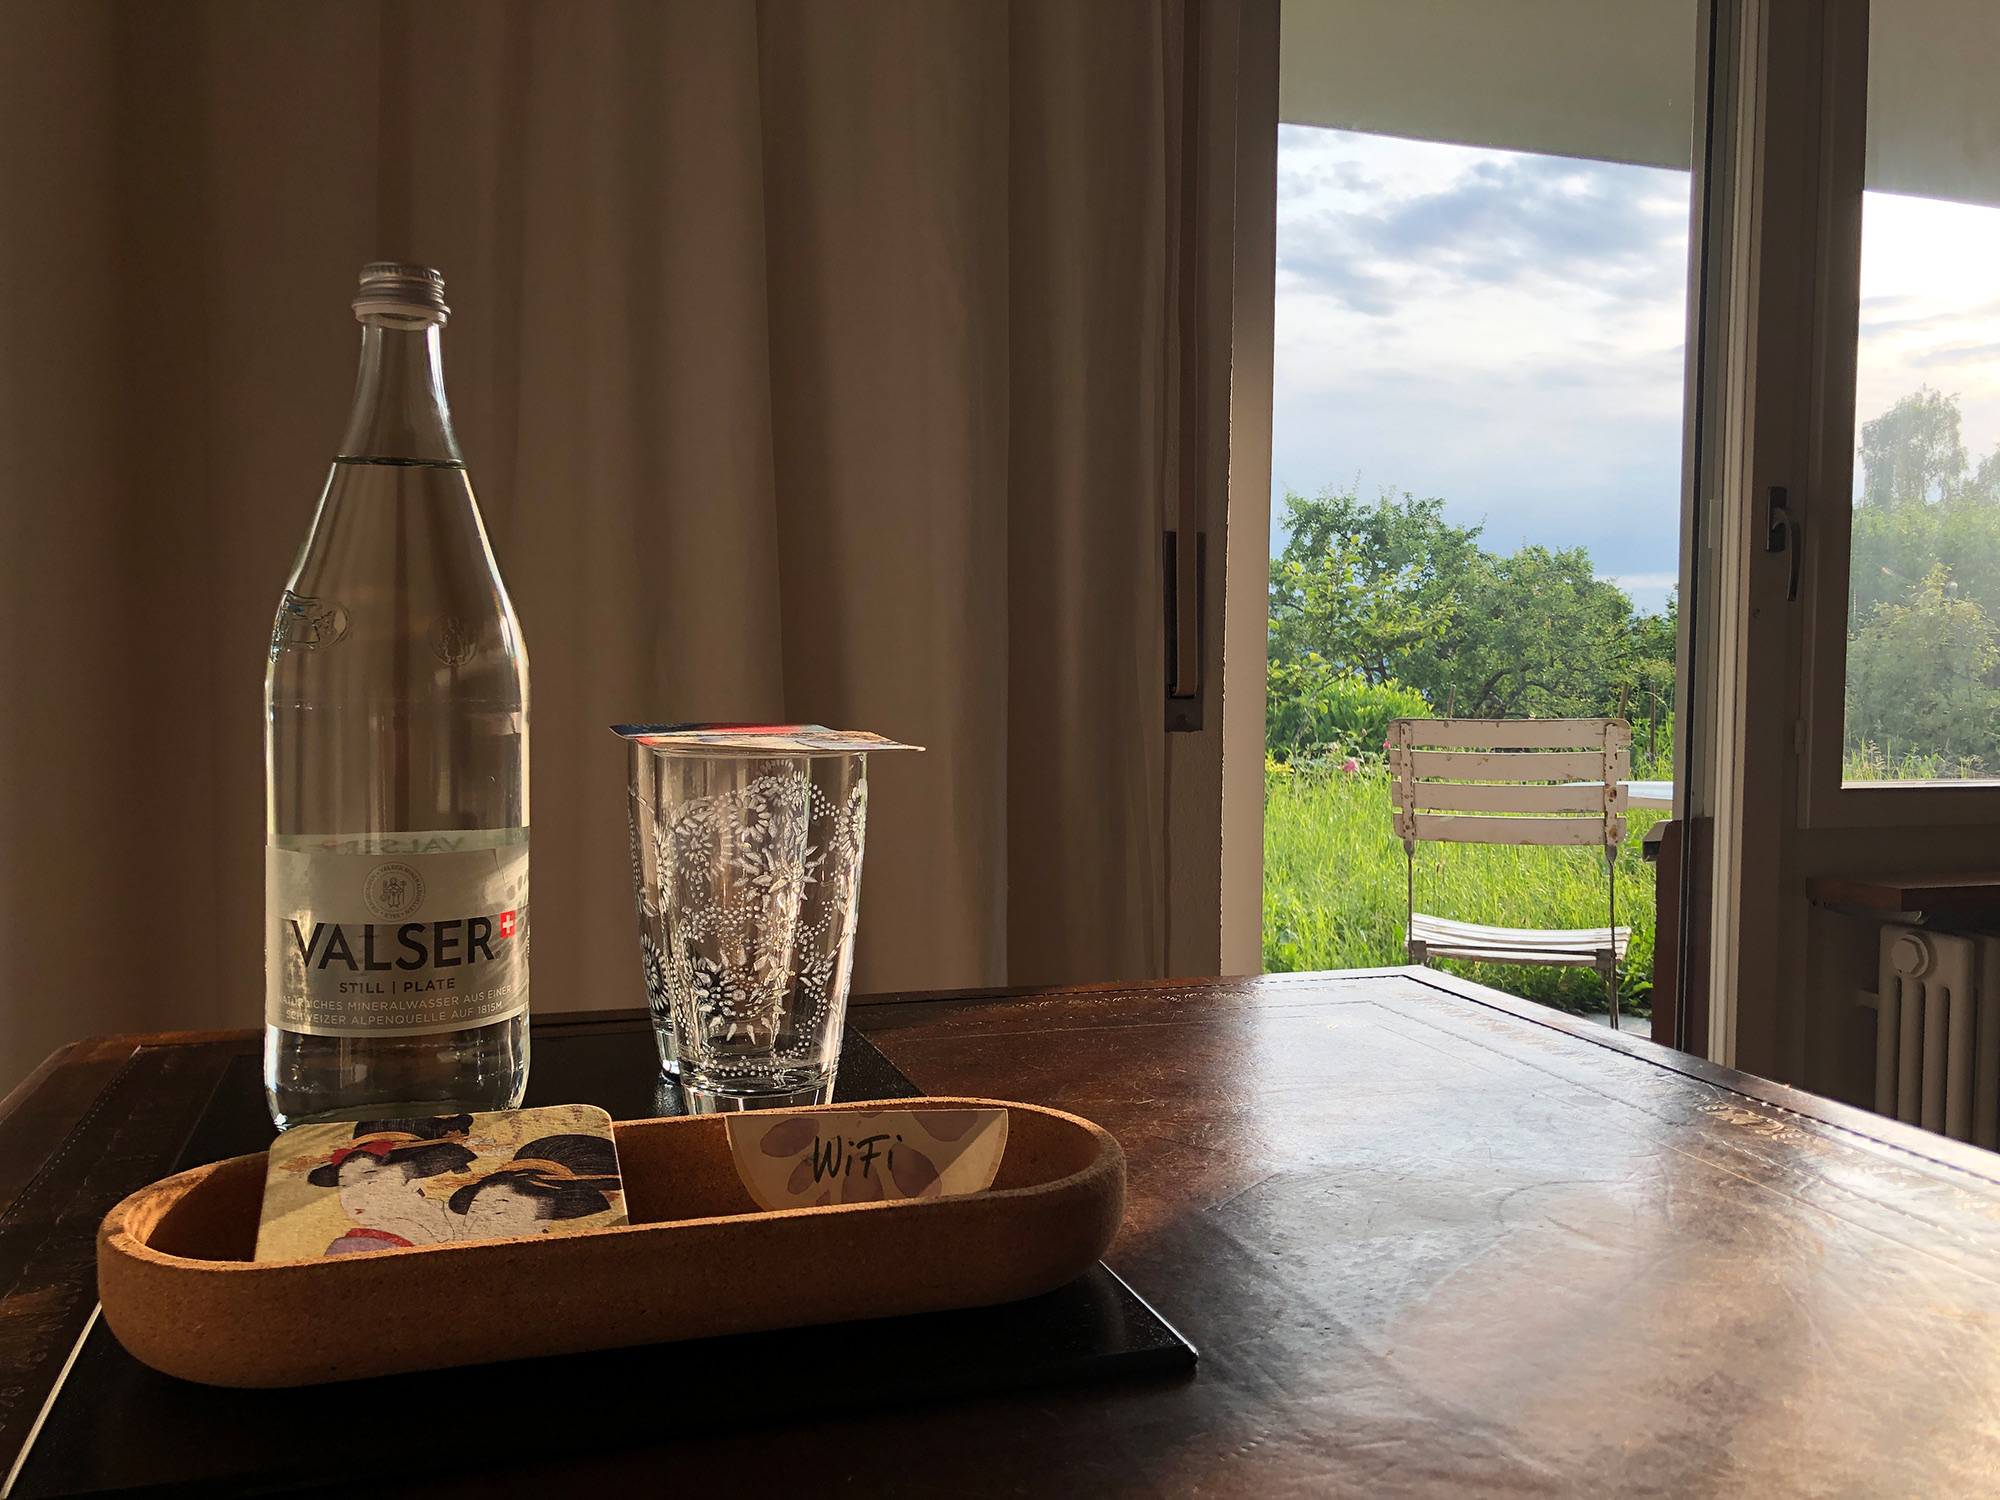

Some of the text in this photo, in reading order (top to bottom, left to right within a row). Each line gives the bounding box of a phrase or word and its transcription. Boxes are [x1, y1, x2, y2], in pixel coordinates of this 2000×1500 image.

[291, 916, 495, 971] VALSER
[279, 984, 512, 1012] ATÜRLICHES MINERALWASSER AUS EINER
[339, 977, 456, 994] STILL PLATE
[286, 1001, 503, 1026] SCHWEIZER ALPENQUELLE AUF 1815M
[813, 1134, 903, 1184] WiFi
